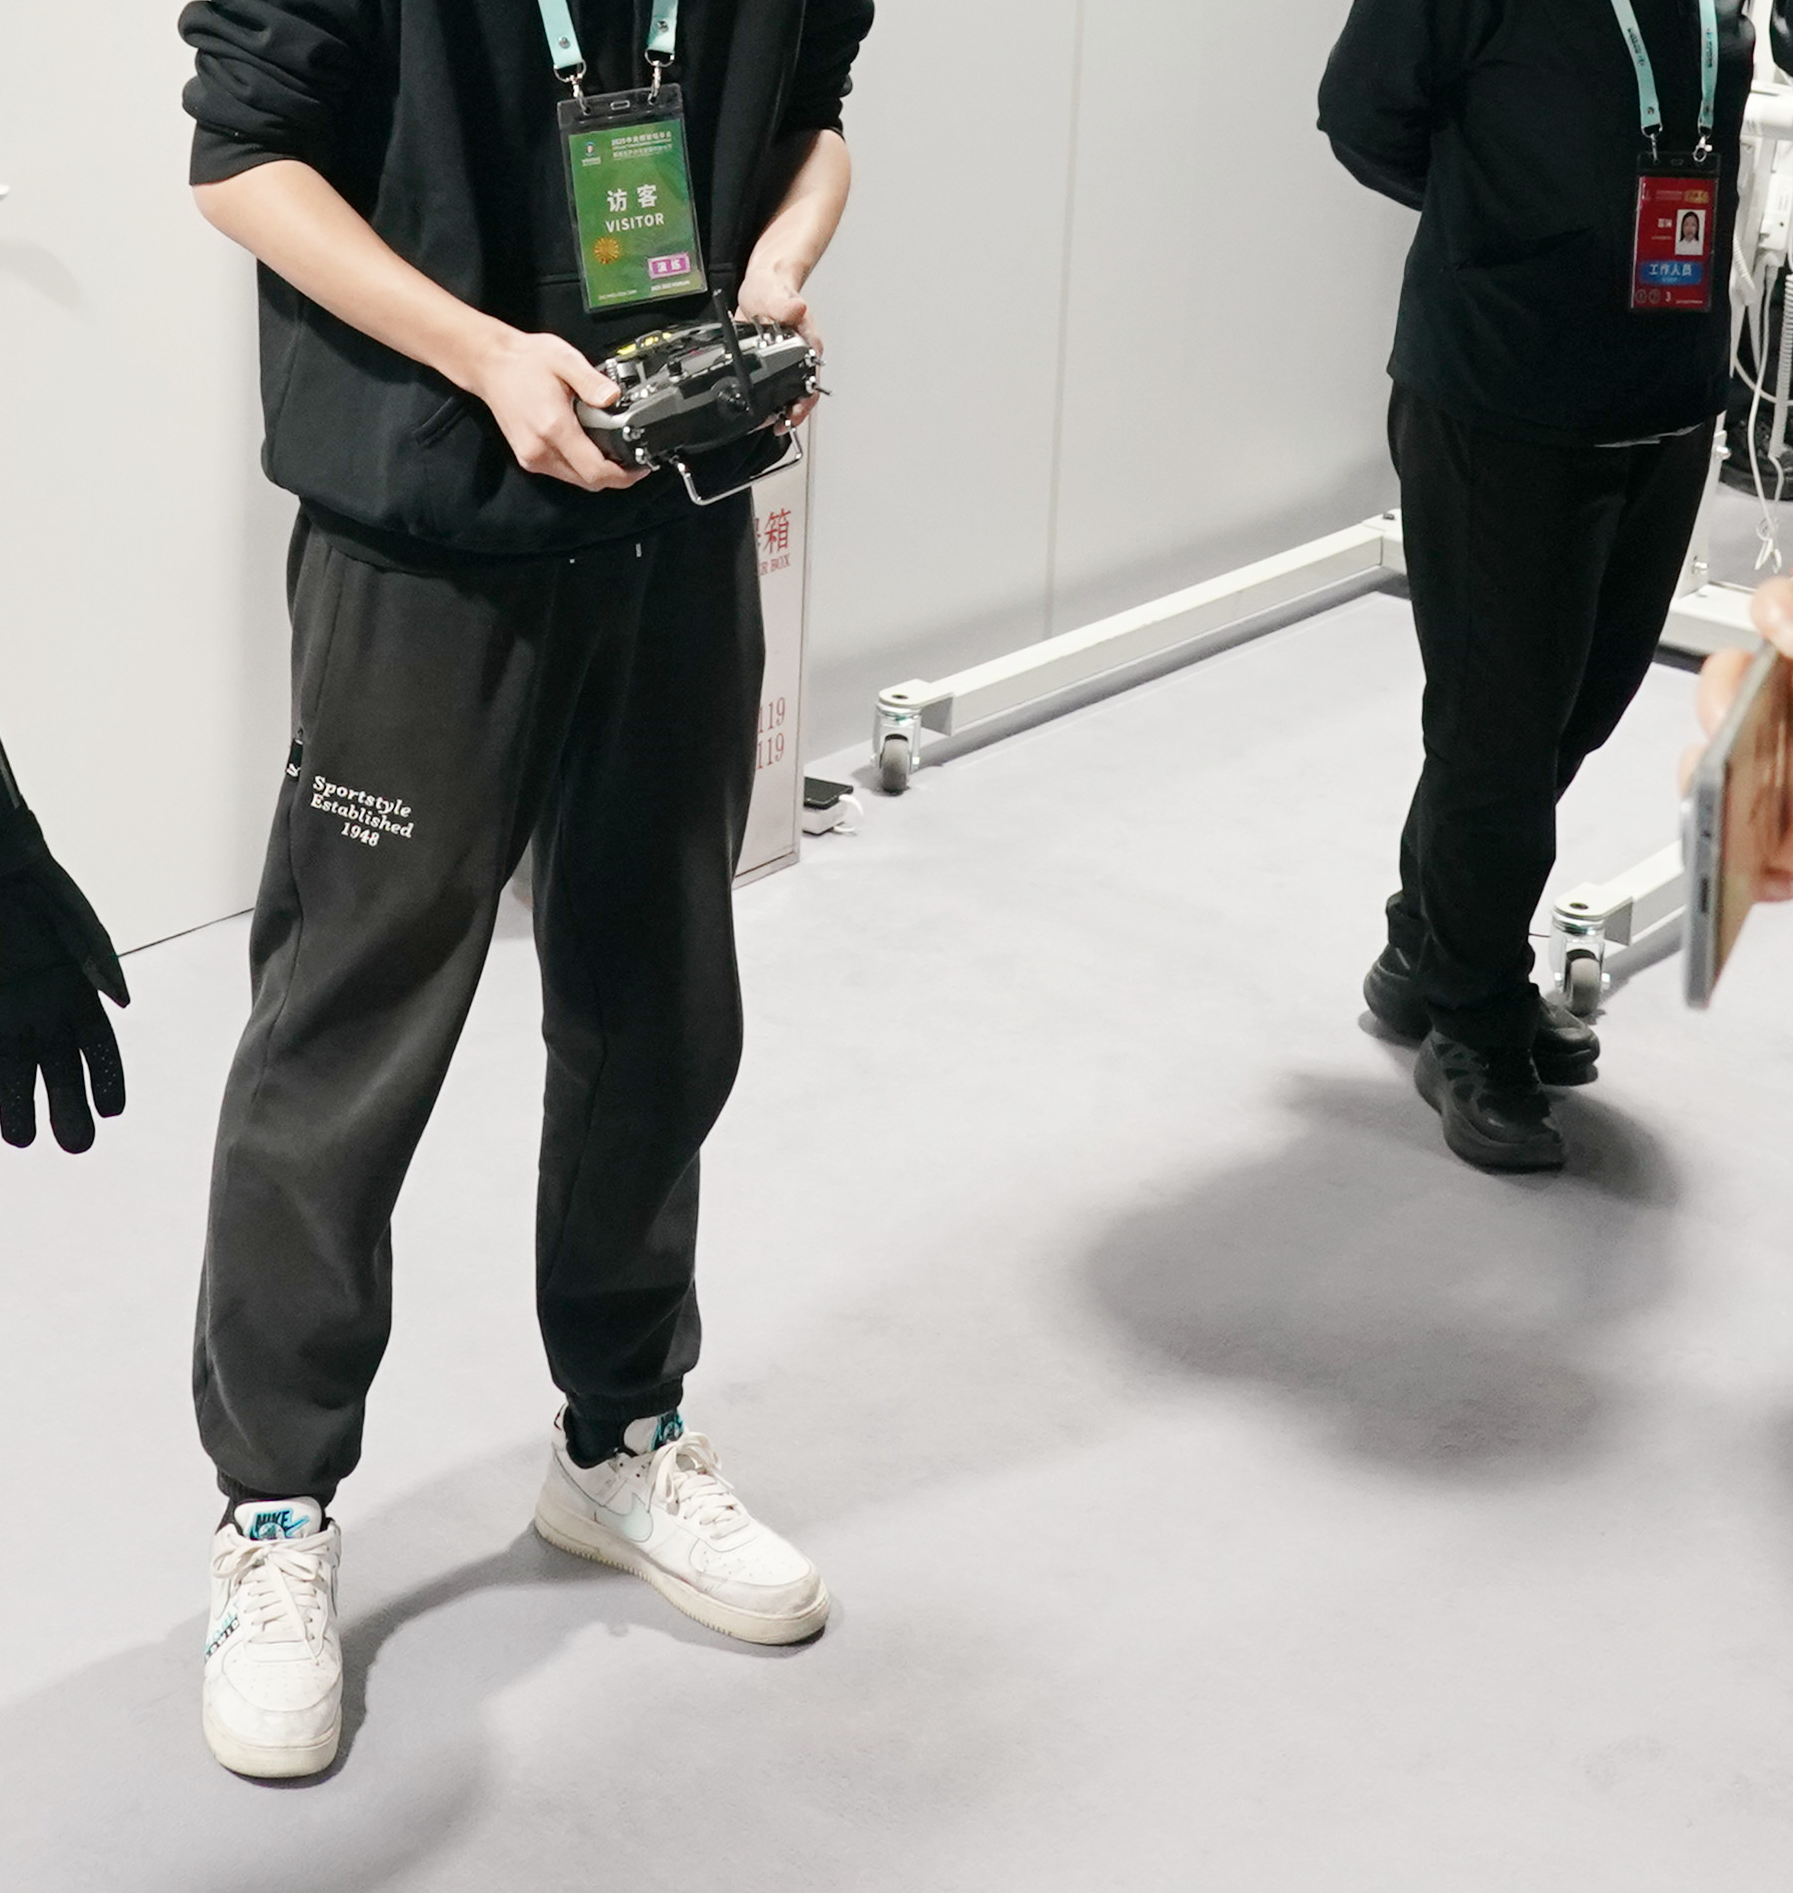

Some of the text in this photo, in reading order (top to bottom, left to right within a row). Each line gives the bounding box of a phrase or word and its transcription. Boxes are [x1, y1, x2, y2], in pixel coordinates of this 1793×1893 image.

[607, 184, 658, 213] 访客
[605, 212, 664, 233] VISITOR
[1649, 264, 1693, 276] 工作人员
[755, 508, 792, 554] 箱
[757, 697, 785, 734] 119
[756, 732, 784, 770] 119
[313, 775, 412, 818] Sportstyle
[310, 793, 414, 839] Established
[341, 822, 380, 847] 1948
[256, 1510, 290, 1529] NIKE
